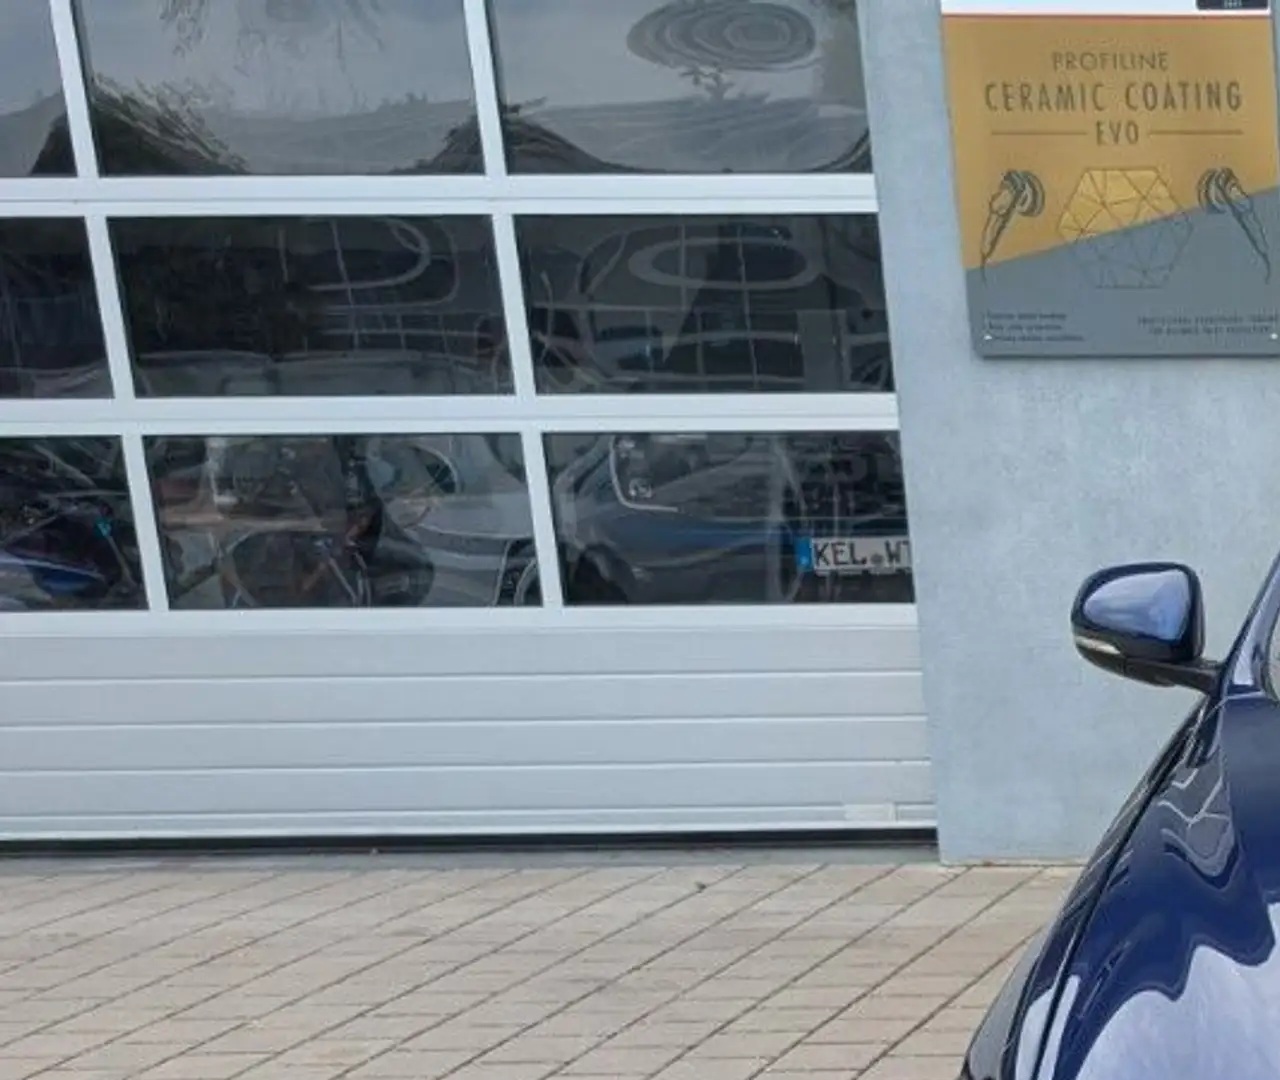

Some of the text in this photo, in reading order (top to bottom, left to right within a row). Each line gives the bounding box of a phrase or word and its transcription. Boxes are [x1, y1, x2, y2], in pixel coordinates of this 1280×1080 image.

[1053, 50, 1170, 71] PROFILINE
[984, 80, 1242, 113] CERAMIC COATING
[1095, 119, 1140, 146] EVO
[814, 541, 868, 566] KEL
